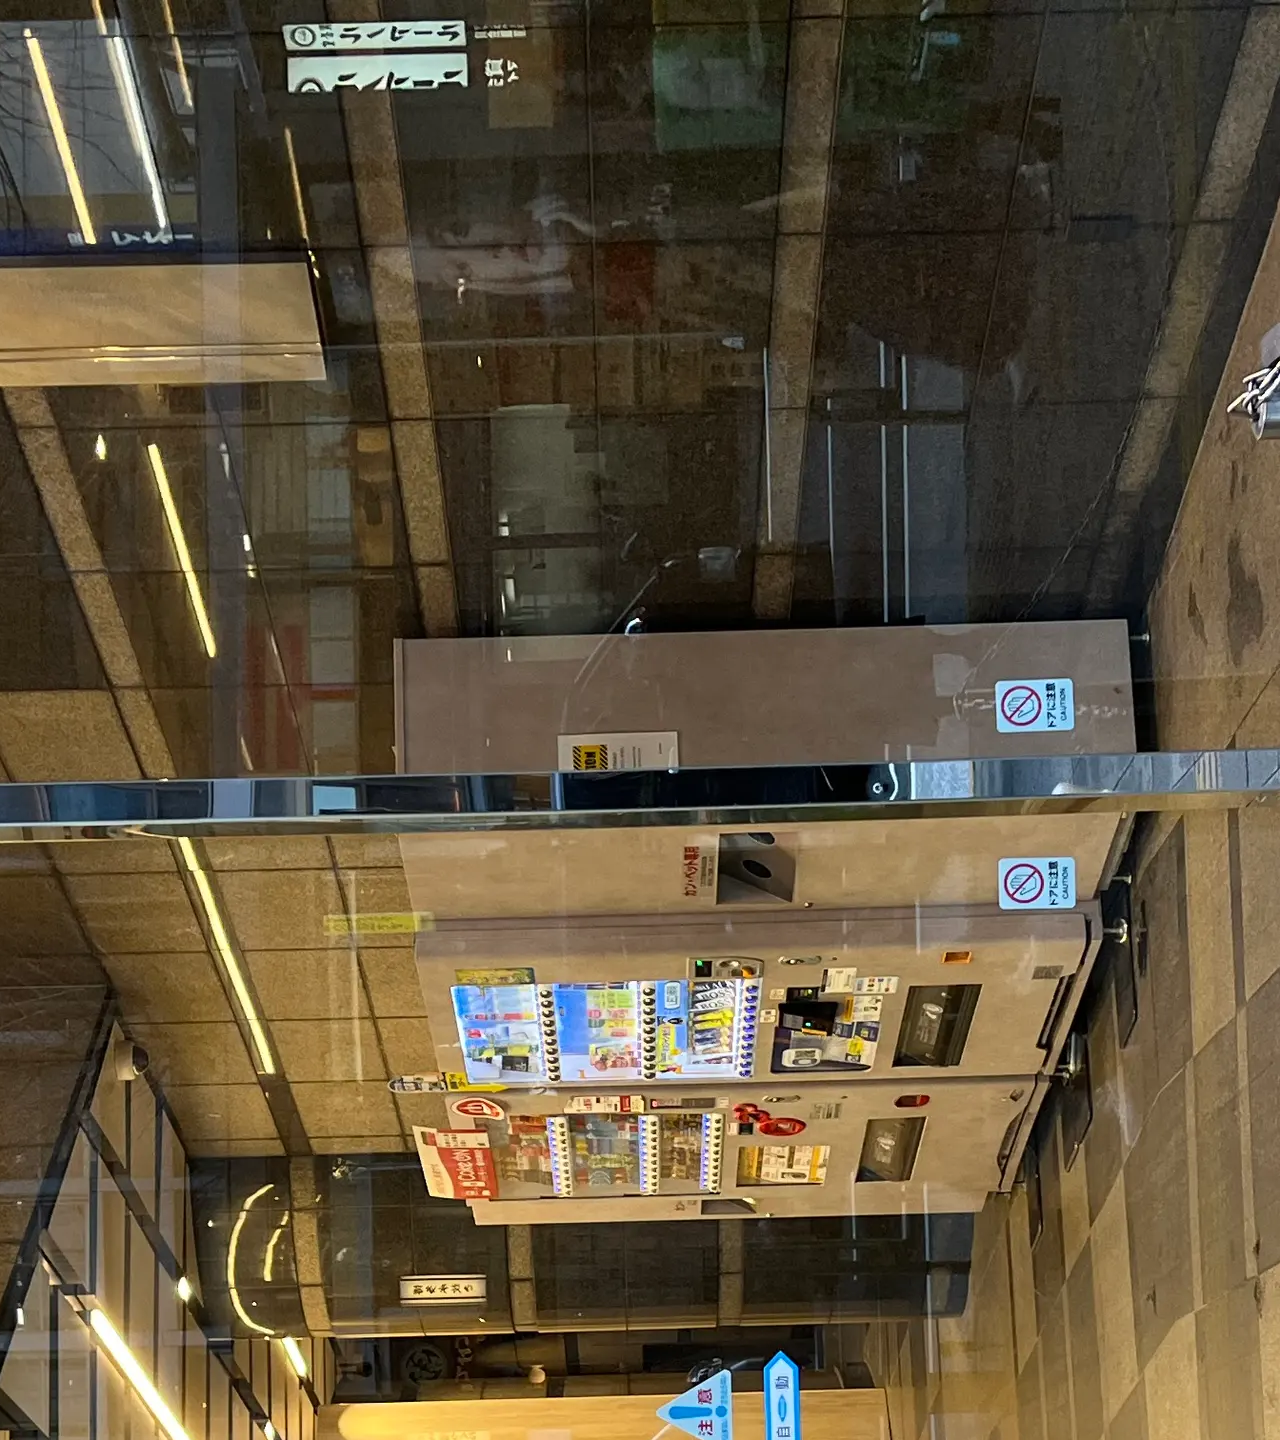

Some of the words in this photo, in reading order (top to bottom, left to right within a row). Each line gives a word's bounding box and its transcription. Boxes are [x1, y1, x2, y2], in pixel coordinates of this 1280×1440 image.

[1045, 682, 1058, 729] ドアに注意
[1059, 687, 1068, 722] CAUTION
[1047, 861, 1059, 906] ドアに注意
[1061, 866, 1070, 899] CAUTION
